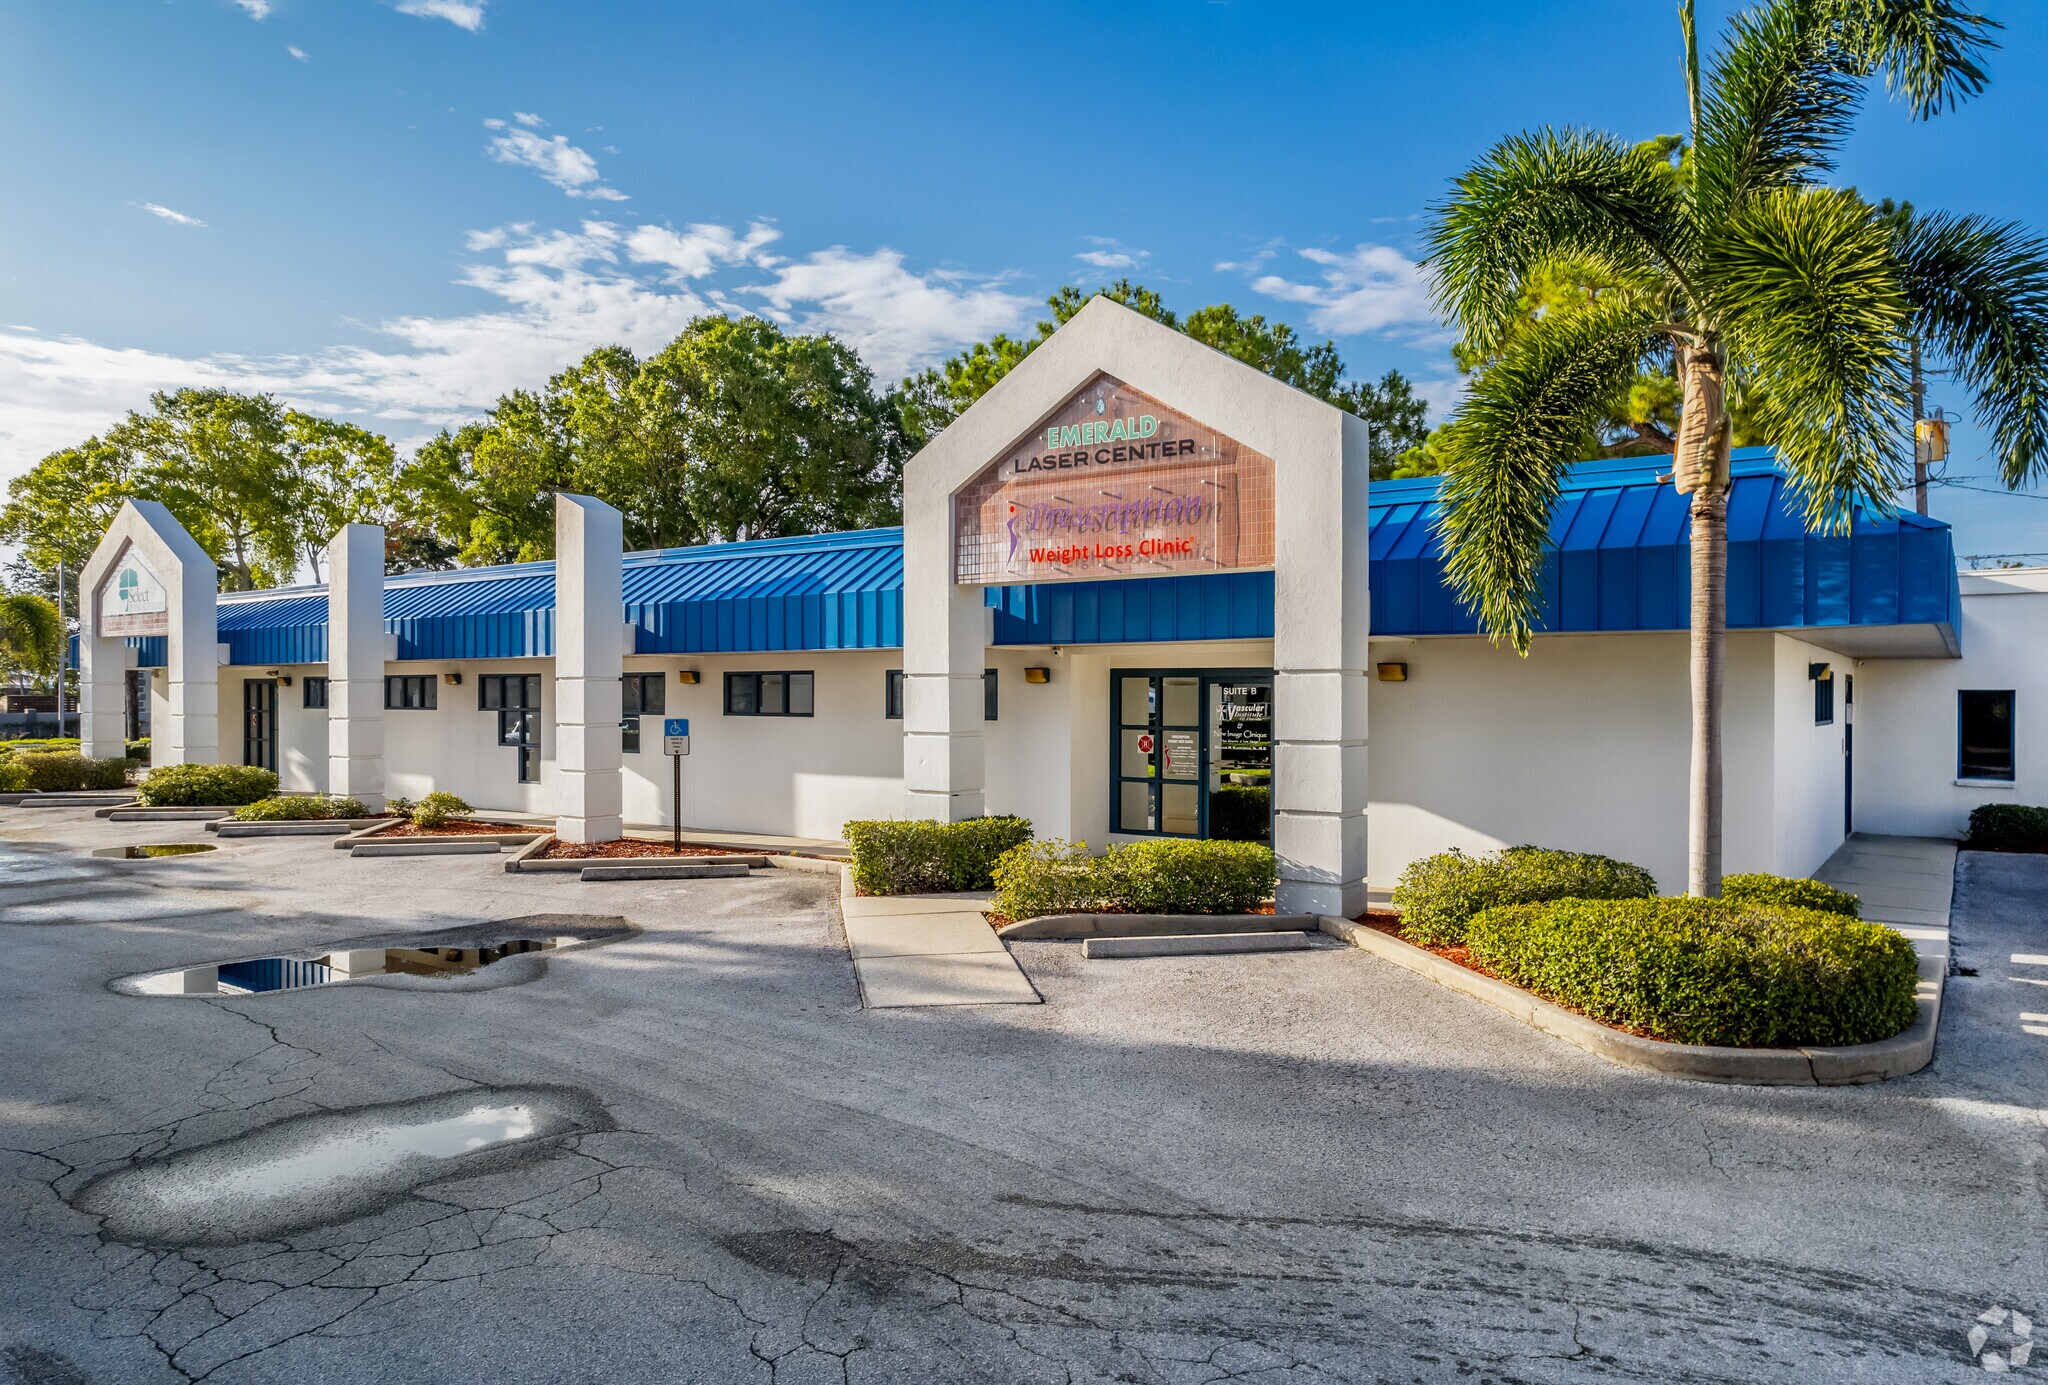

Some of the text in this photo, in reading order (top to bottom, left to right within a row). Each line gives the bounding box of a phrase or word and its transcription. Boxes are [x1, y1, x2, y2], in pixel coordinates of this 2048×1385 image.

[1047, 415, 1158, 449] EMERALD
[1015, 438, 1195, 473] LASER CENTER
[1026, 491, 1203, 534] Prescription
[1029, 537, 1191, 564] Weight Loss Clinic
[129, 587, 149, 603] Select
[1223, 687, 1257, 695] SUITE B
[1228, 703, 1264, 720] Vascular
[1227, 730, 1242, 739] Image
[1243, 730, 1267, 741] Clinique
